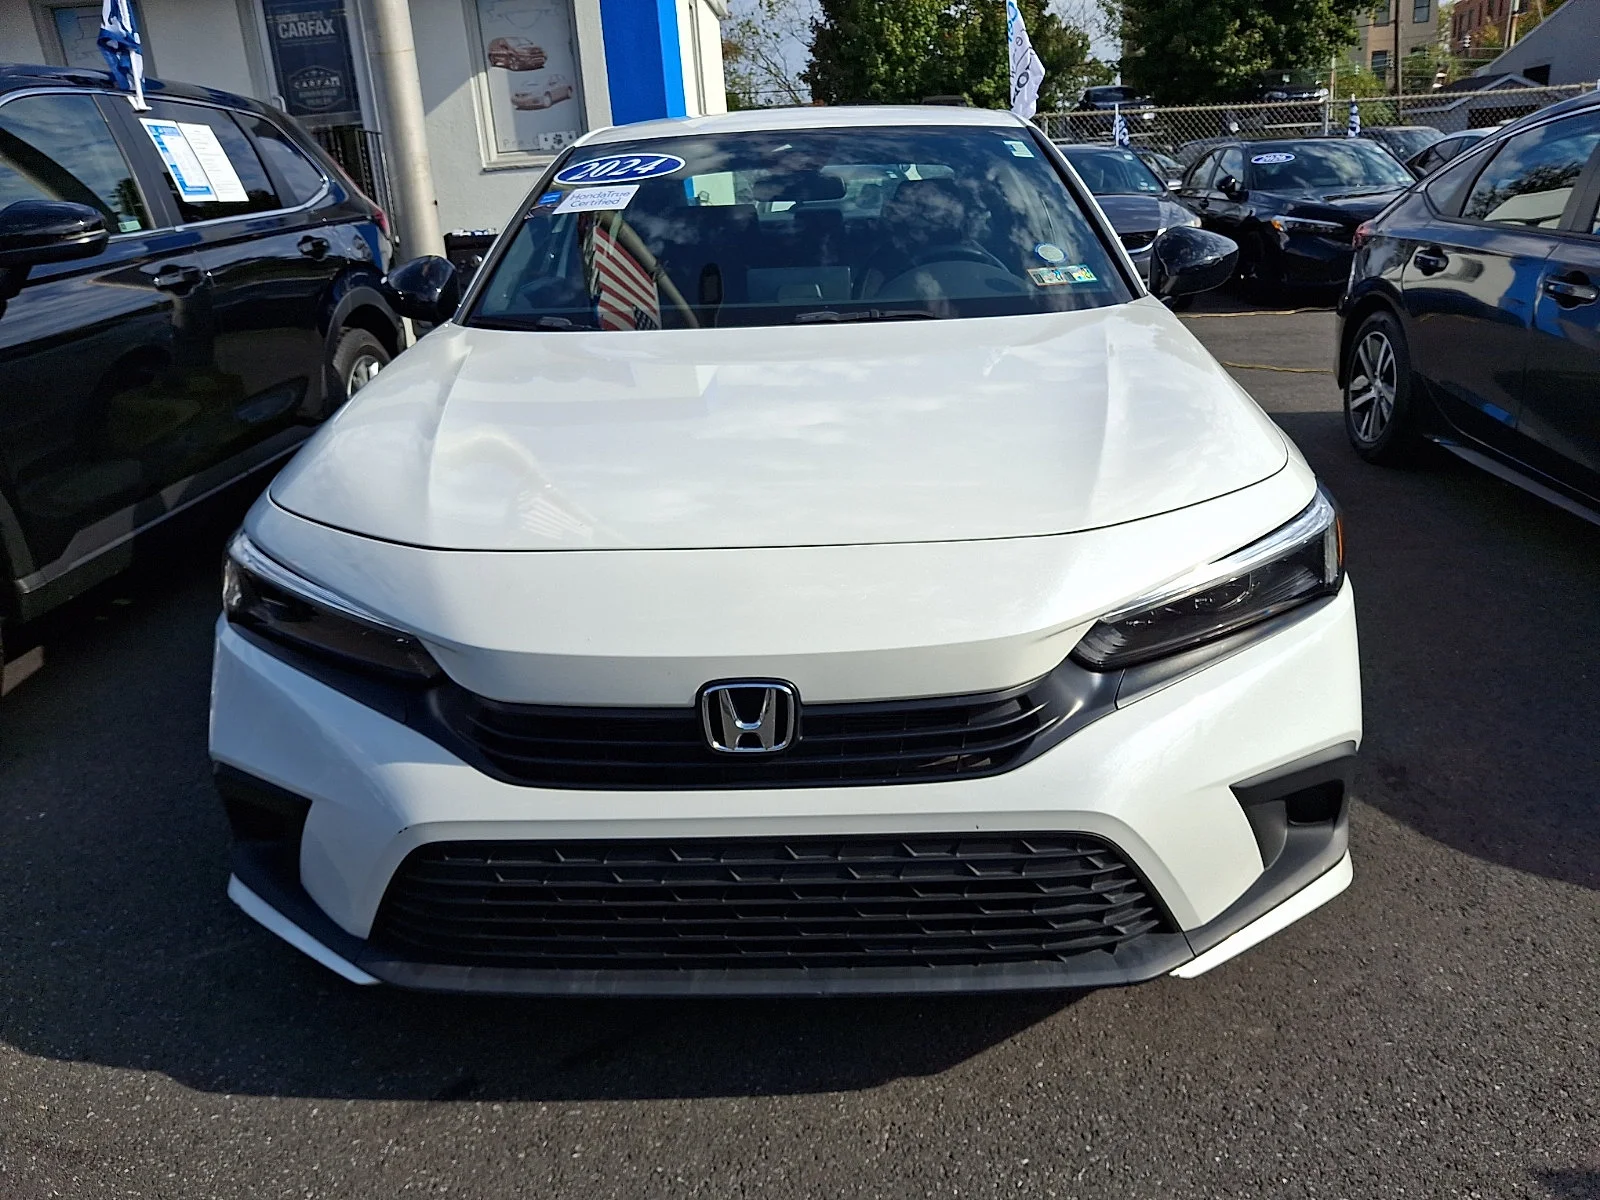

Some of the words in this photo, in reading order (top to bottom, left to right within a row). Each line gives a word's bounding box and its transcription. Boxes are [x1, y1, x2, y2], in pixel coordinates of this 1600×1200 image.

[278, 19, 335, 39] CARFAX
[567, 157, 669, 181] 2024
[570, 199, 620, 208] Certified
